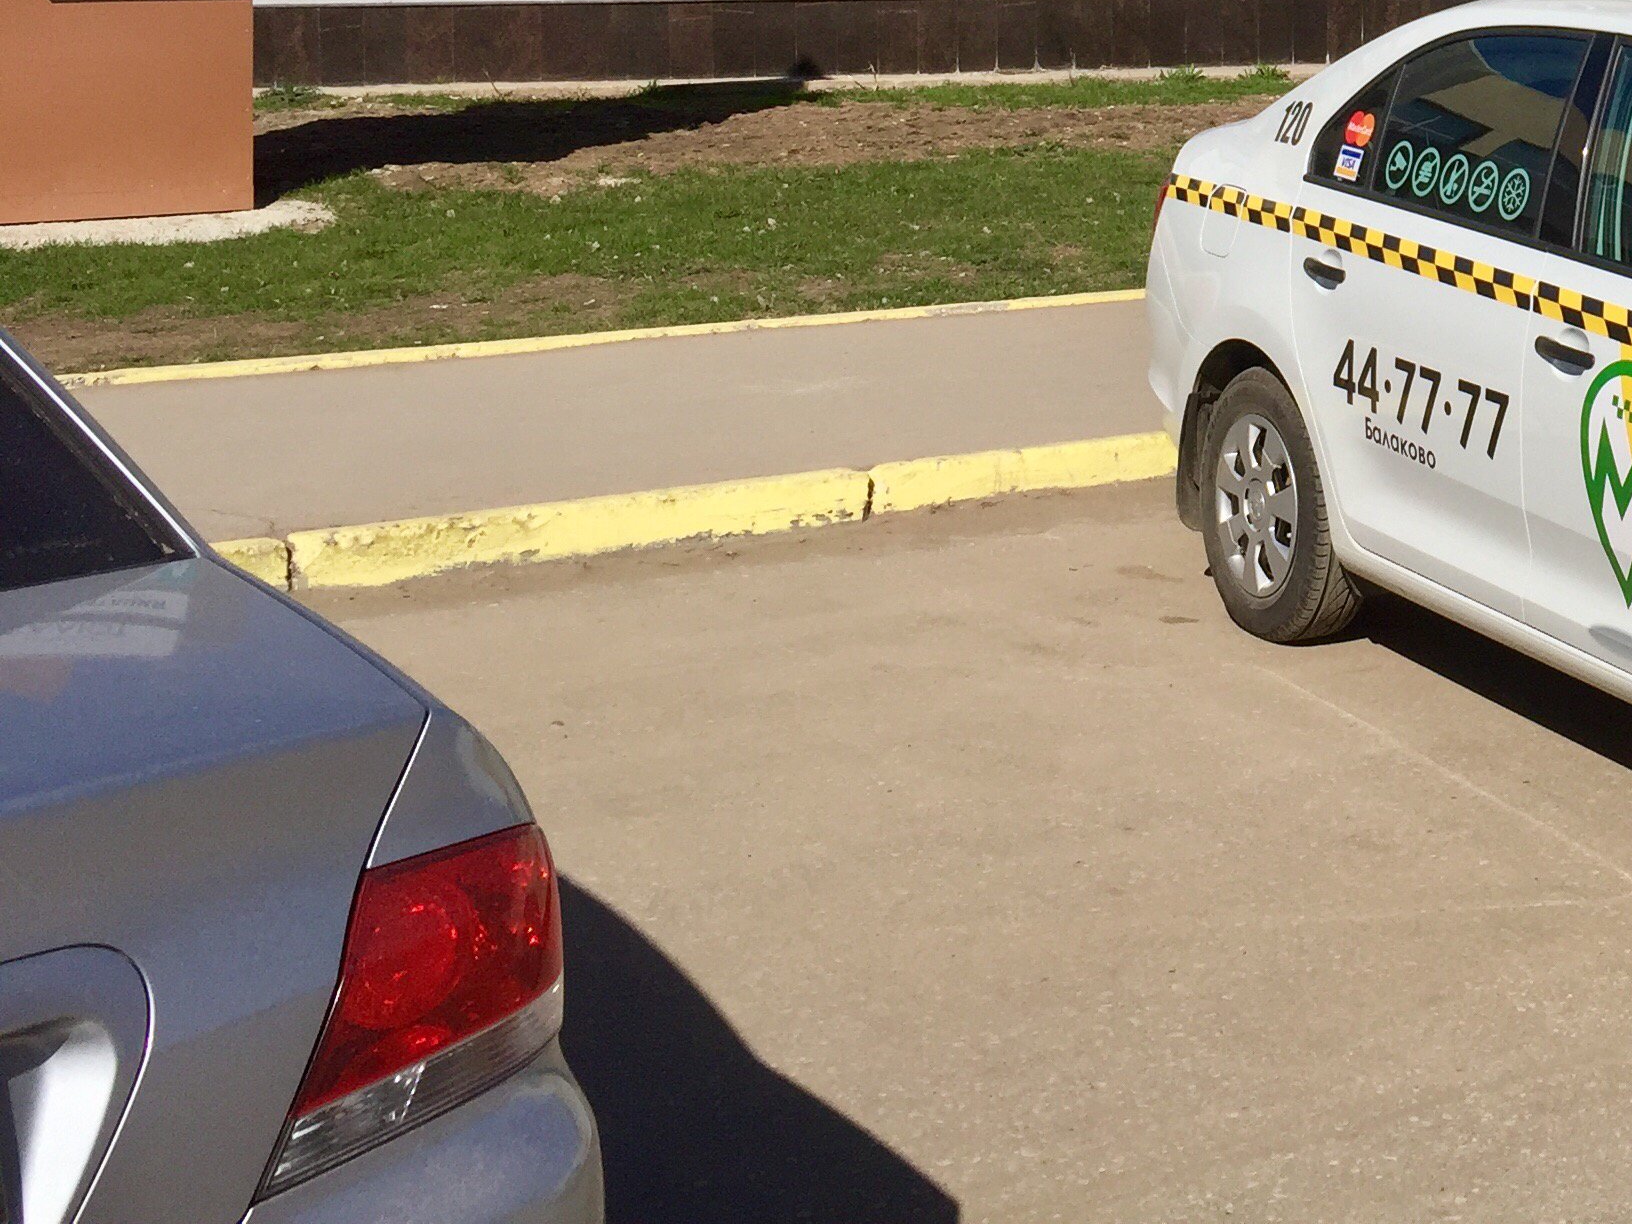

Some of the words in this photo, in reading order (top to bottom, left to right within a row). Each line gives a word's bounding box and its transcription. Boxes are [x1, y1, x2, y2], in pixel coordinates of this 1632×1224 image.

[1274, 101, 1313, 146] 120
[1341, 157, 1357, 170] VISA
[1364, 417, 1437, 470] Балаково
